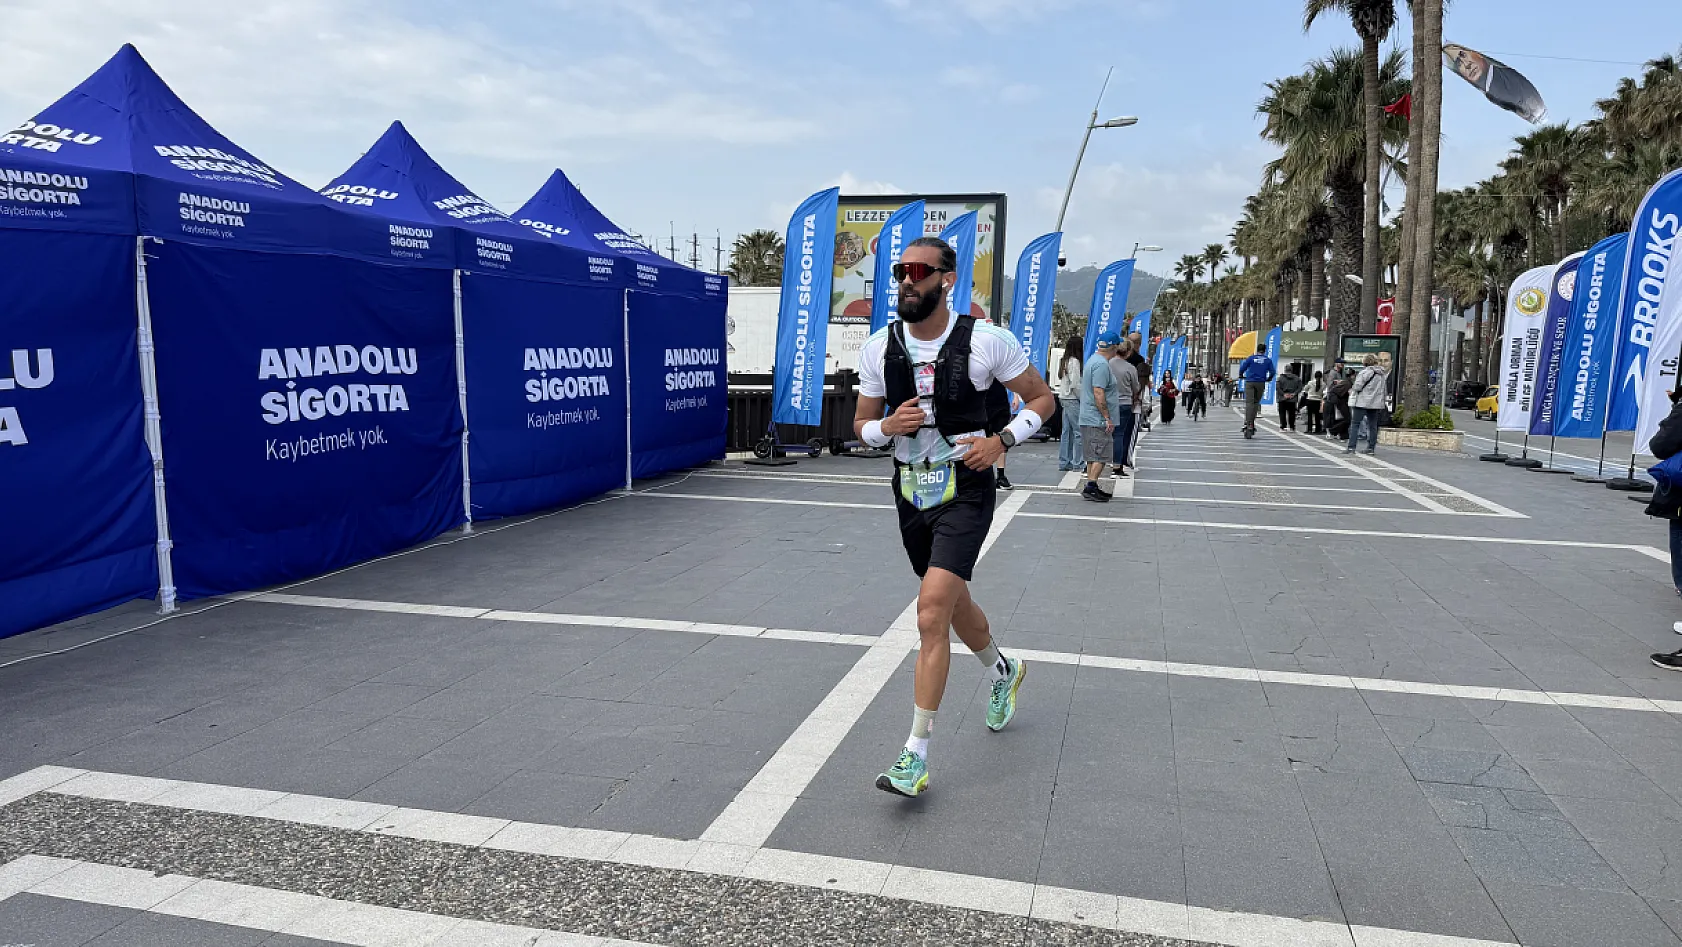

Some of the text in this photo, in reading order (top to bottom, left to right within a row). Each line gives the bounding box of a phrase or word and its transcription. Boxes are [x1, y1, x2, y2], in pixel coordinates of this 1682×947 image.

[0, 168, 88, 190] ANADOLU
[179, 192, 251, 214] ANADOLU
[179, 206, 246, 227] SİGORTA
[1023, 252, 1041, 323] SİGORTA
[1630, 207, 1679, 349] BROOKS
[791, 213, 816, 411] ANADOLU SİGORTA
[1571, 252, 1607, 421] ANADOLU SİGORTA
[258, 344, 418, 380] ANADOLU
[523, 347, 613, 371] ANADOLU
[664, 348, 719, 366] ANADOLU
[1506, 338, 1523, 403] MUĞLA ORMAN
[1660, 356, 1679, 376] T.C.
[524, 371, 610, 402] SİGORTA
[665, 366, 716, 391] SİGORTA
[260, 380, 410, 425] SİGORTA
[527, 406, 600, 430] Kaybetmek yok.
[1541, 390, 1555, 423] MUĞLA
[266, 425, 388, 462] Kaybetmek yok.
[916, 470, 944, 486] 1260
